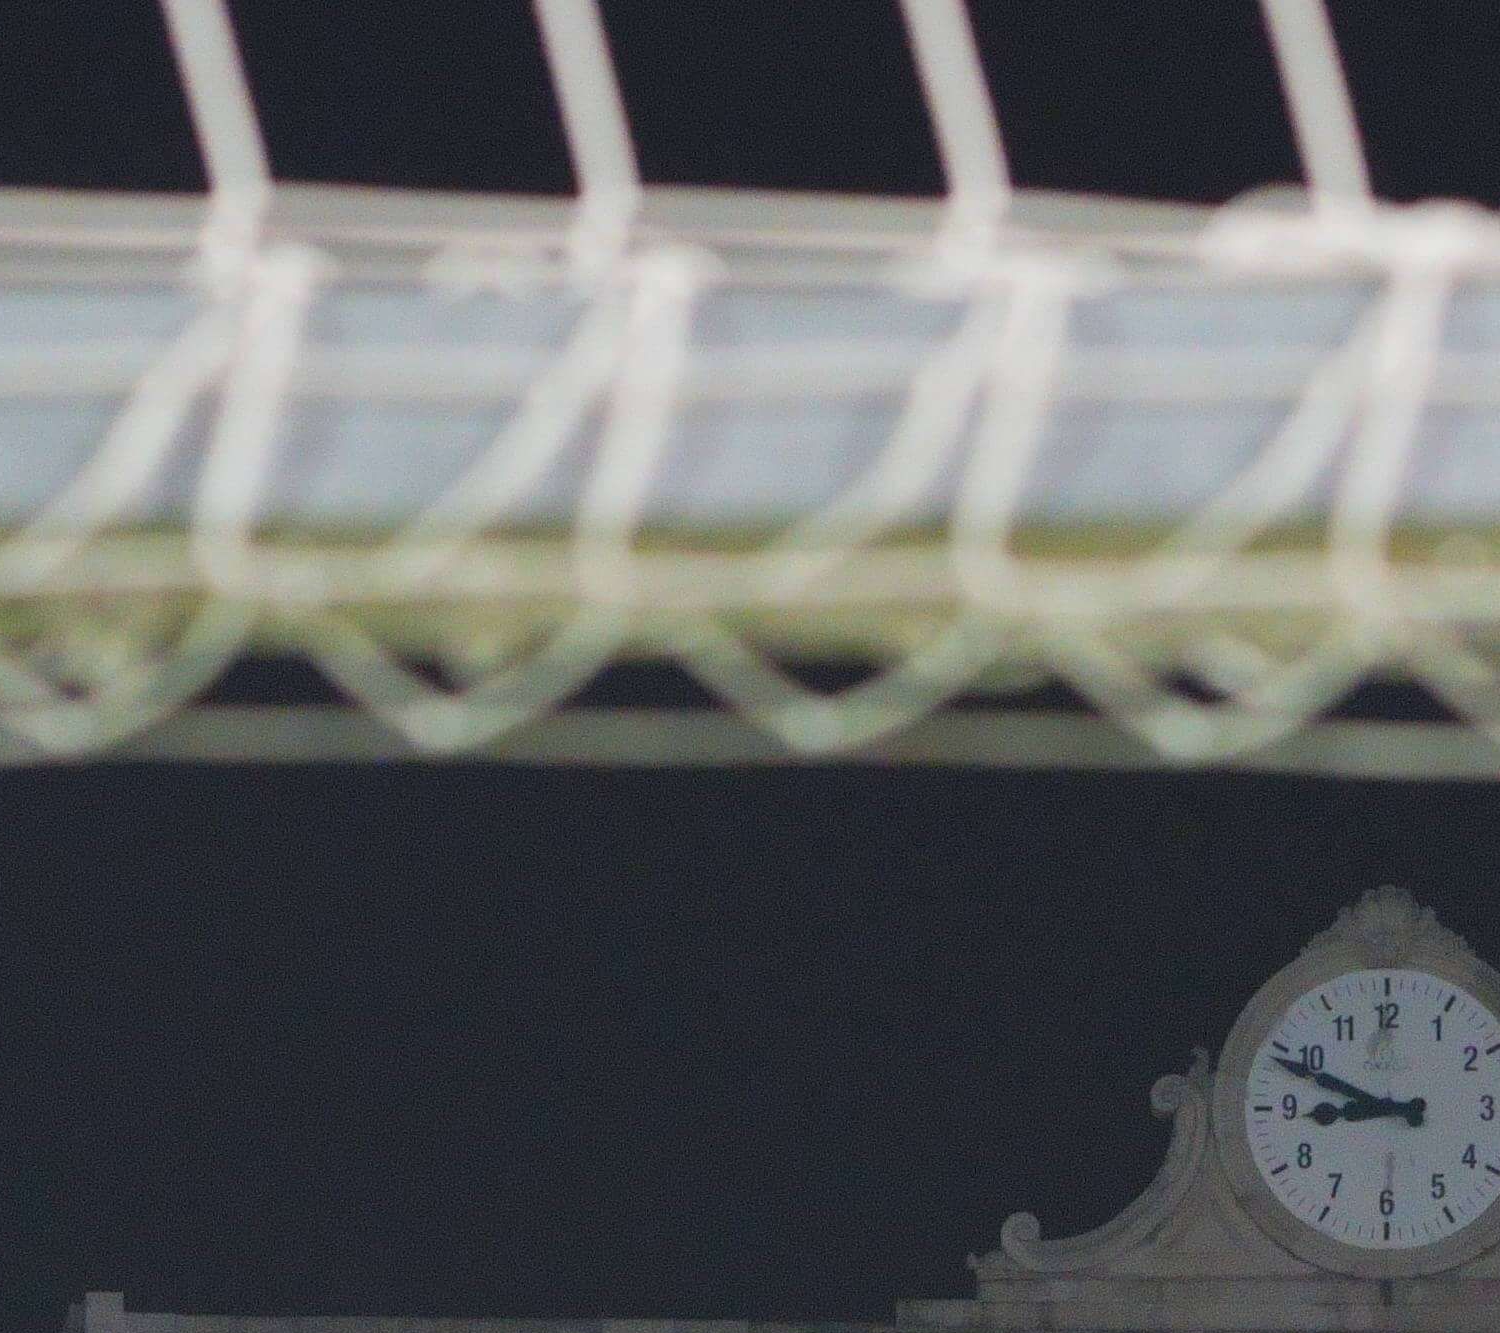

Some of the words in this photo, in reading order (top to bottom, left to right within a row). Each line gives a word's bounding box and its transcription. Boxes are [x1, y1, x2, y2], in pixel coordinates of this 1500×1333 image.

[1333, 1015, 1354, 1041] 11
[1375, 1002, 1399, 1031] 12
[1431, 1015, 1443, 1042] 1
[1299, 1045, 1324, 1071] 10
[1463, 1045, 1478, 1072] 2
[1282, 1093, 1297, 1121] 9
[1479, 1094, 1495, 1122] 3
[1297, 1142, 1312, 1170] 8
[1461, 1143, 1477, 1170] 4
[1328, 1173, 1342, 1199] 7
[1431, 1173, 1446, 1200] 5
[1379, 1188, 1395, 1217] 6
